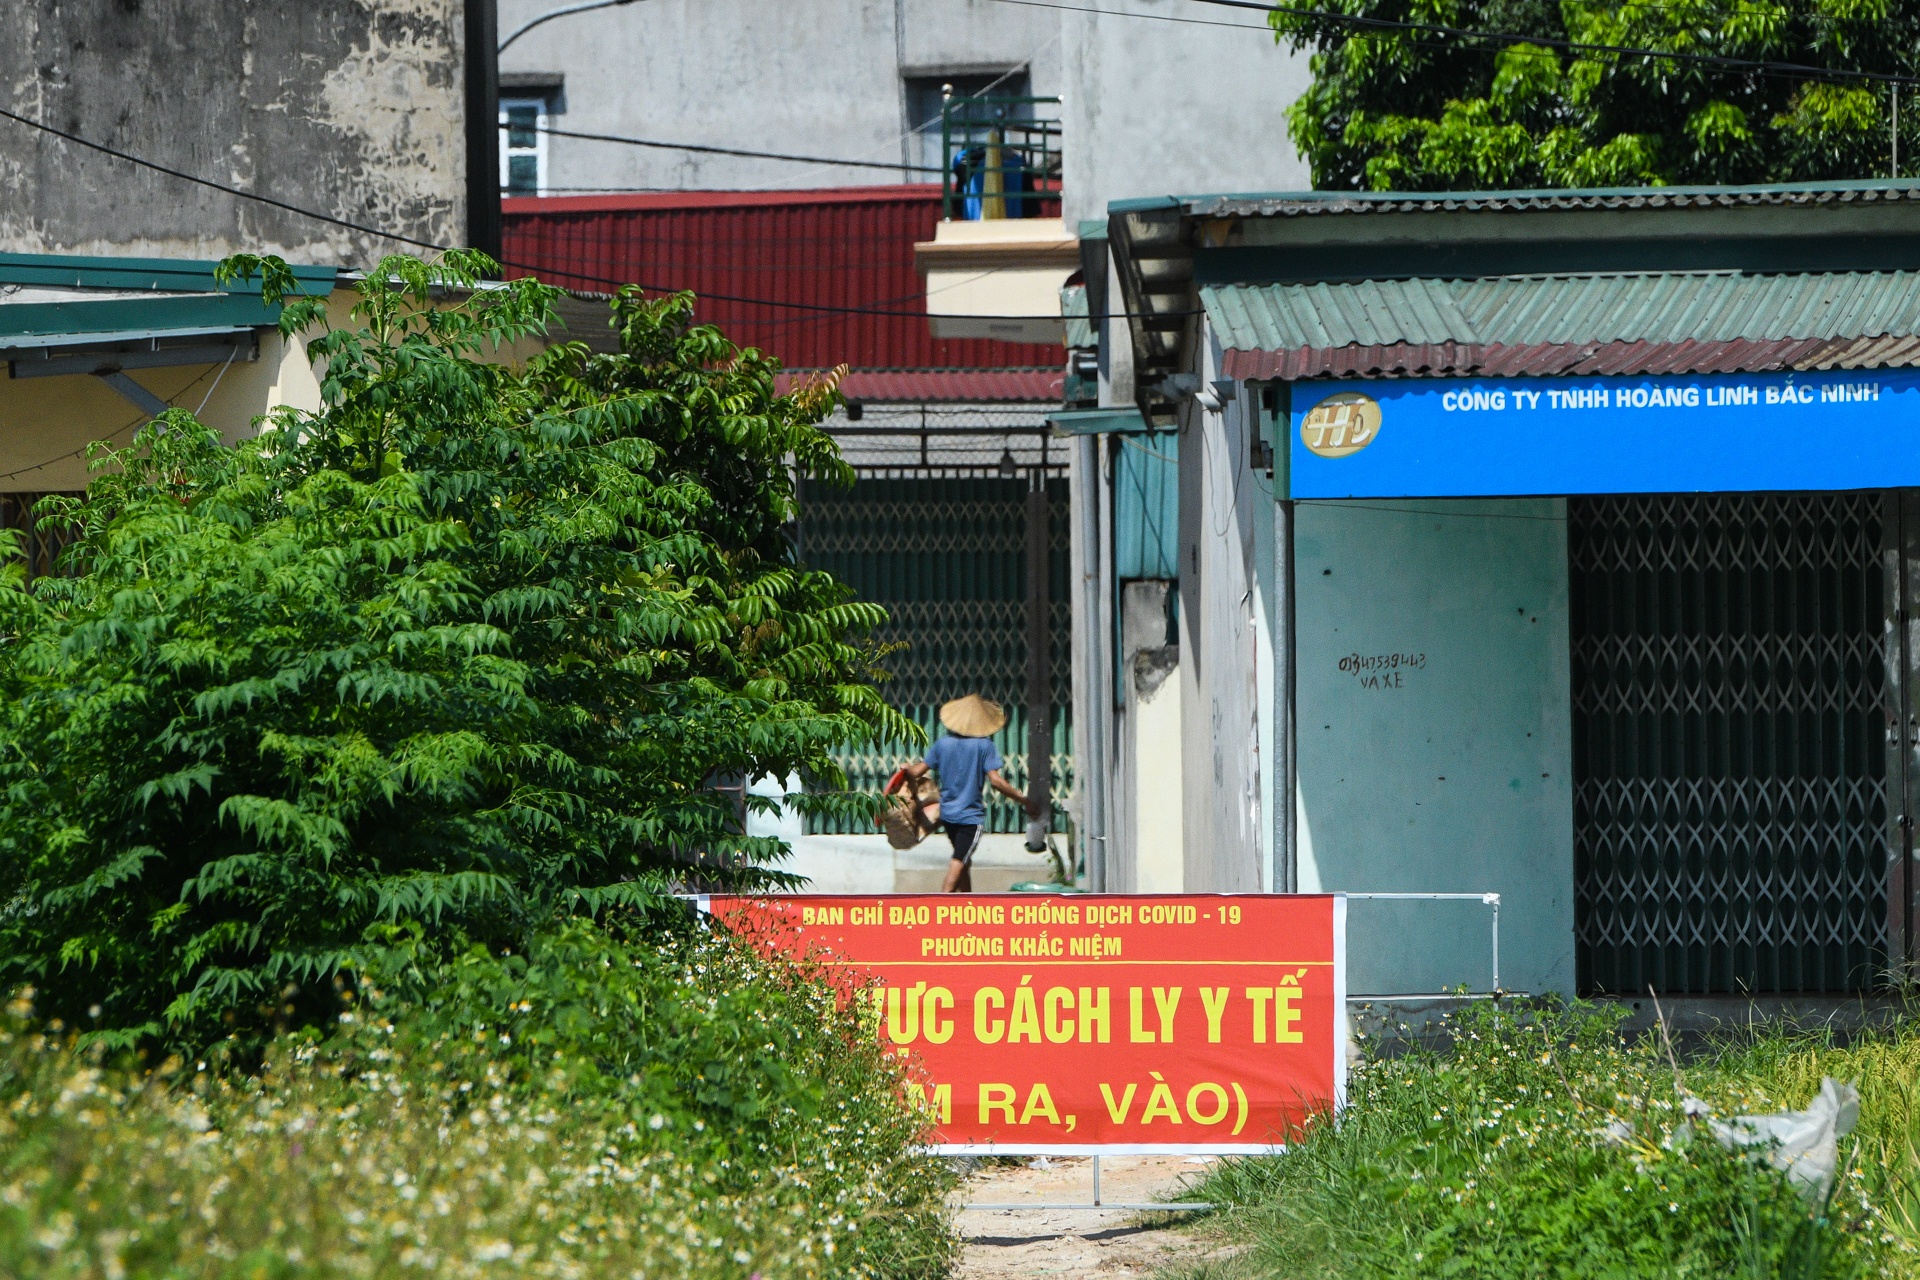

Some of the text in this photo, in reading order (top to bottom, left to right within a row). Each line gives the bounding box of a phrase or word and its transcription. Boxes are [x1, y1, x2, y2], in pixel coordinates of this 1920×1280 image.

[1442, 373, 1880, 411] CÔNG TY TNHH HOÀNG LINH BẮC NINH
[802, 907, 844, 925] BAN
[850, 900, 883, 926] CHỈ
[889, 905, 930, 930] ĐẠO
[936, 901, 1004, 925] PHÒNG
[1011, 899, 1080, 925] CHỐNG
[1085, 905, 1133, 929] DỊCH
[1138, 905, 1197, 925] COVID
[1217, 905, 1241, 925] 19
[921, 930, 1123, 960] PHƯỜNG KHẮC NIỆM
[973, 974, 1111, 1044] CÁCH
[1129, 986, 1183, 1043] LY
[1199, 987, 1230, 1043] Y
[1245, 968, 1308, 1044] TẾ
[978, 1082, 1077, 1133] RA,
[1098, 1071, 1249, 1136] VÀO)
